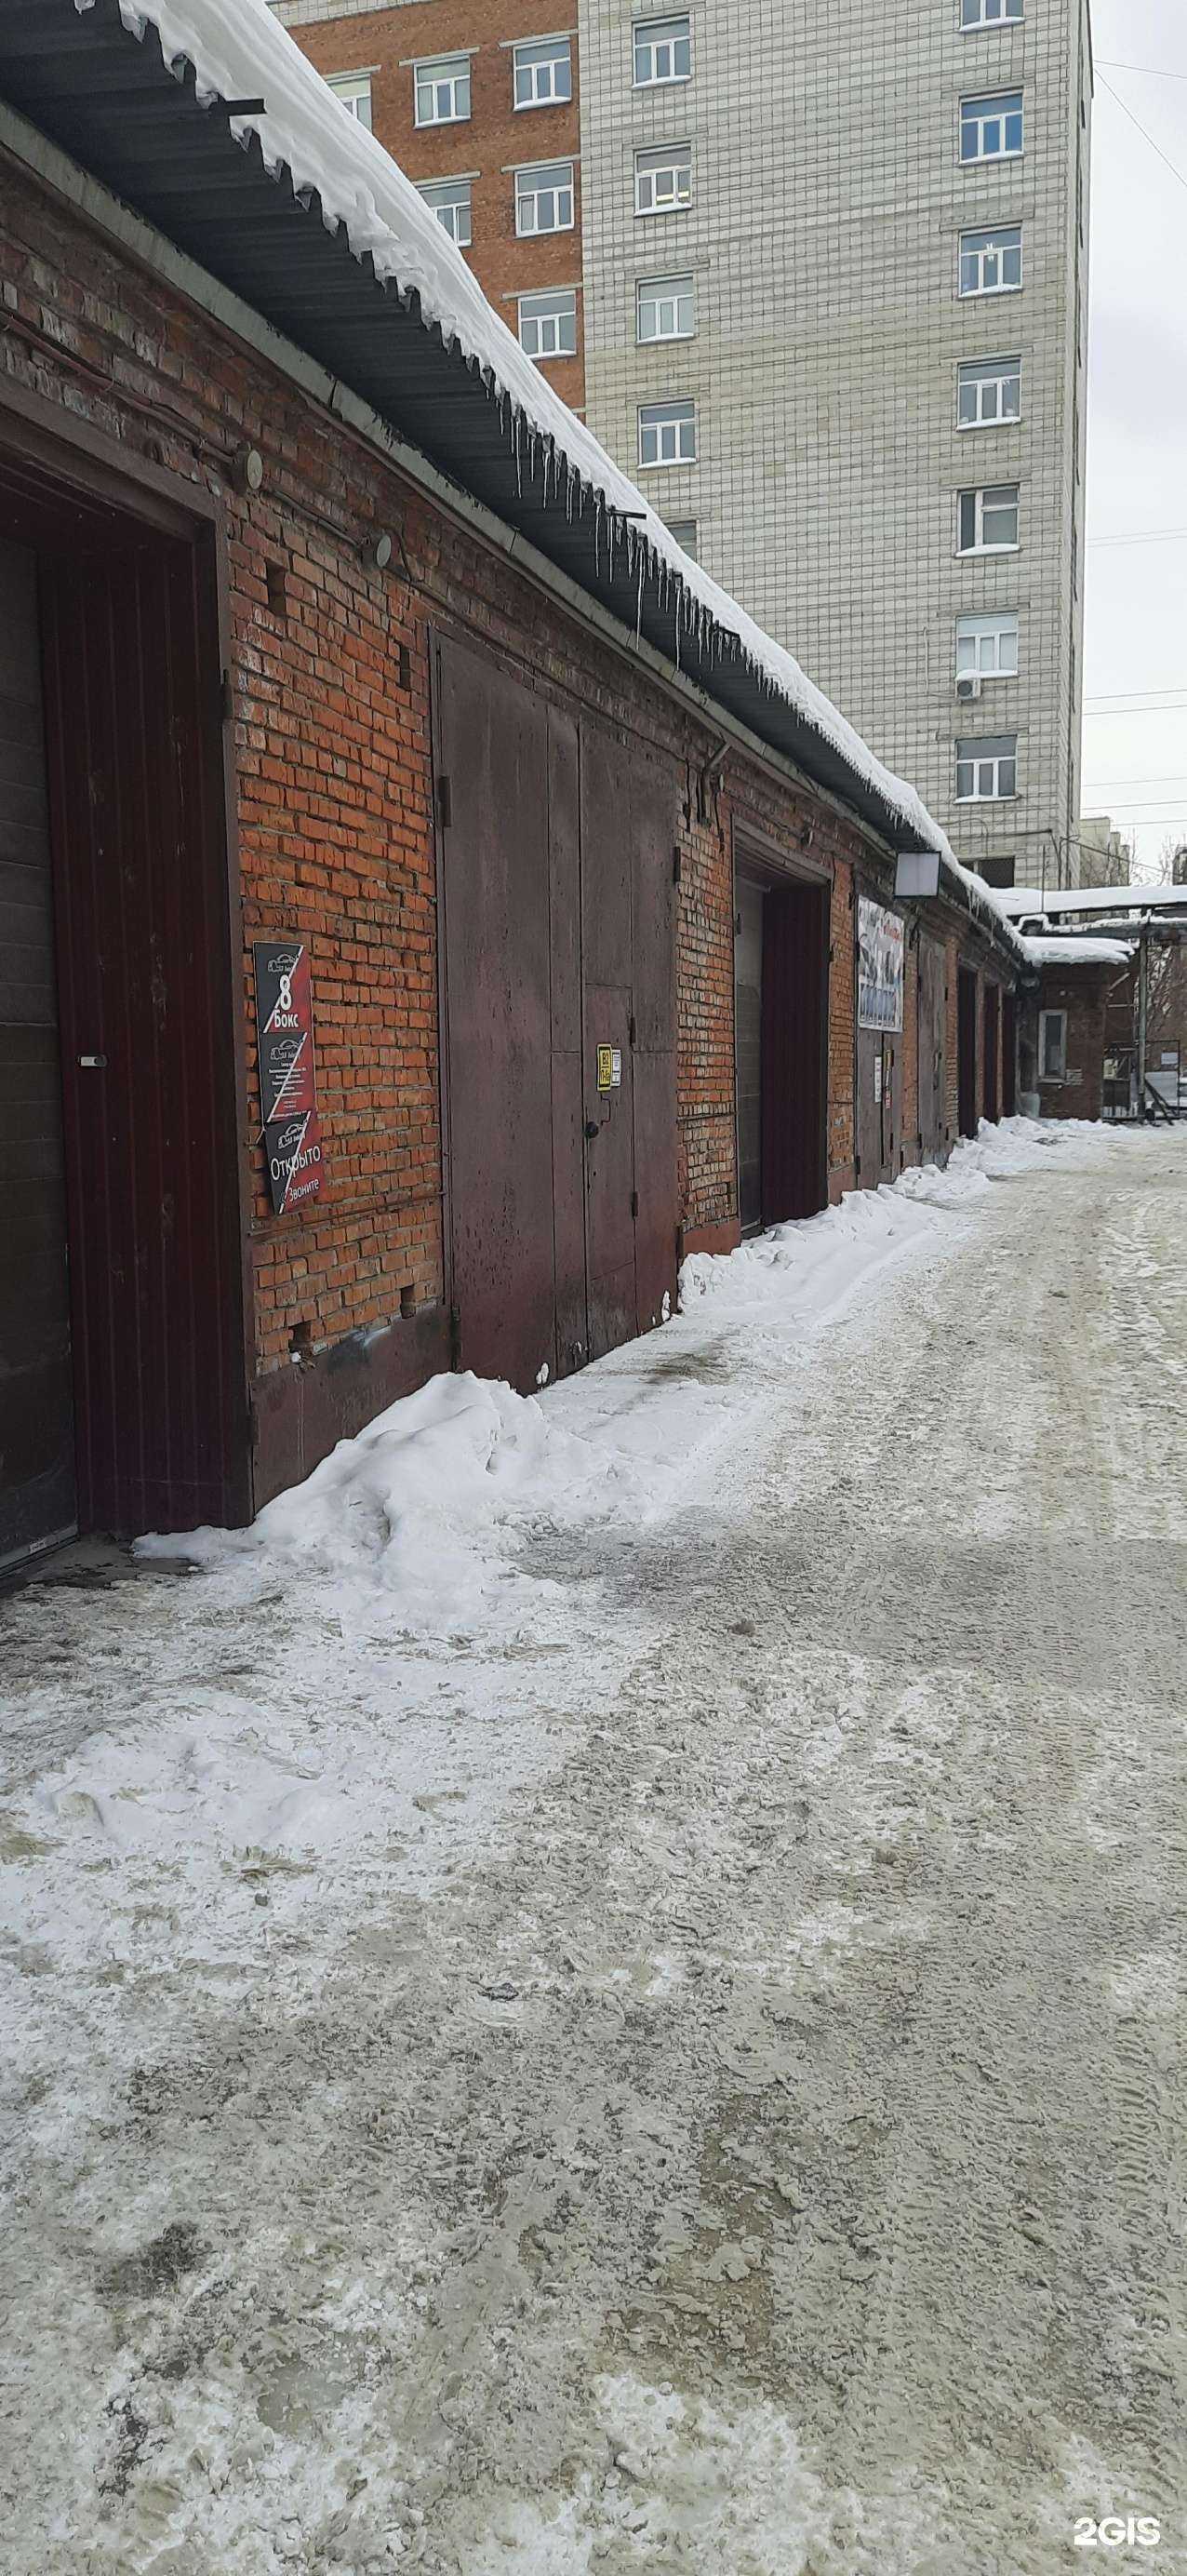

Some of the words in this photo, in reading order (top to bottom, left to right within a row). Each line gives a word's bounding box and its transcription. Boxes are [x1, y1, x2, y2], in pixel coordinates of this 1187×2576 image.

[280, 974, 292, 1011] 8
[273, 1010, 300, 1028] Бокс
[271, 1146, 321, 1181] Открыто
[288, 1178, 319, 1201] Звоните
